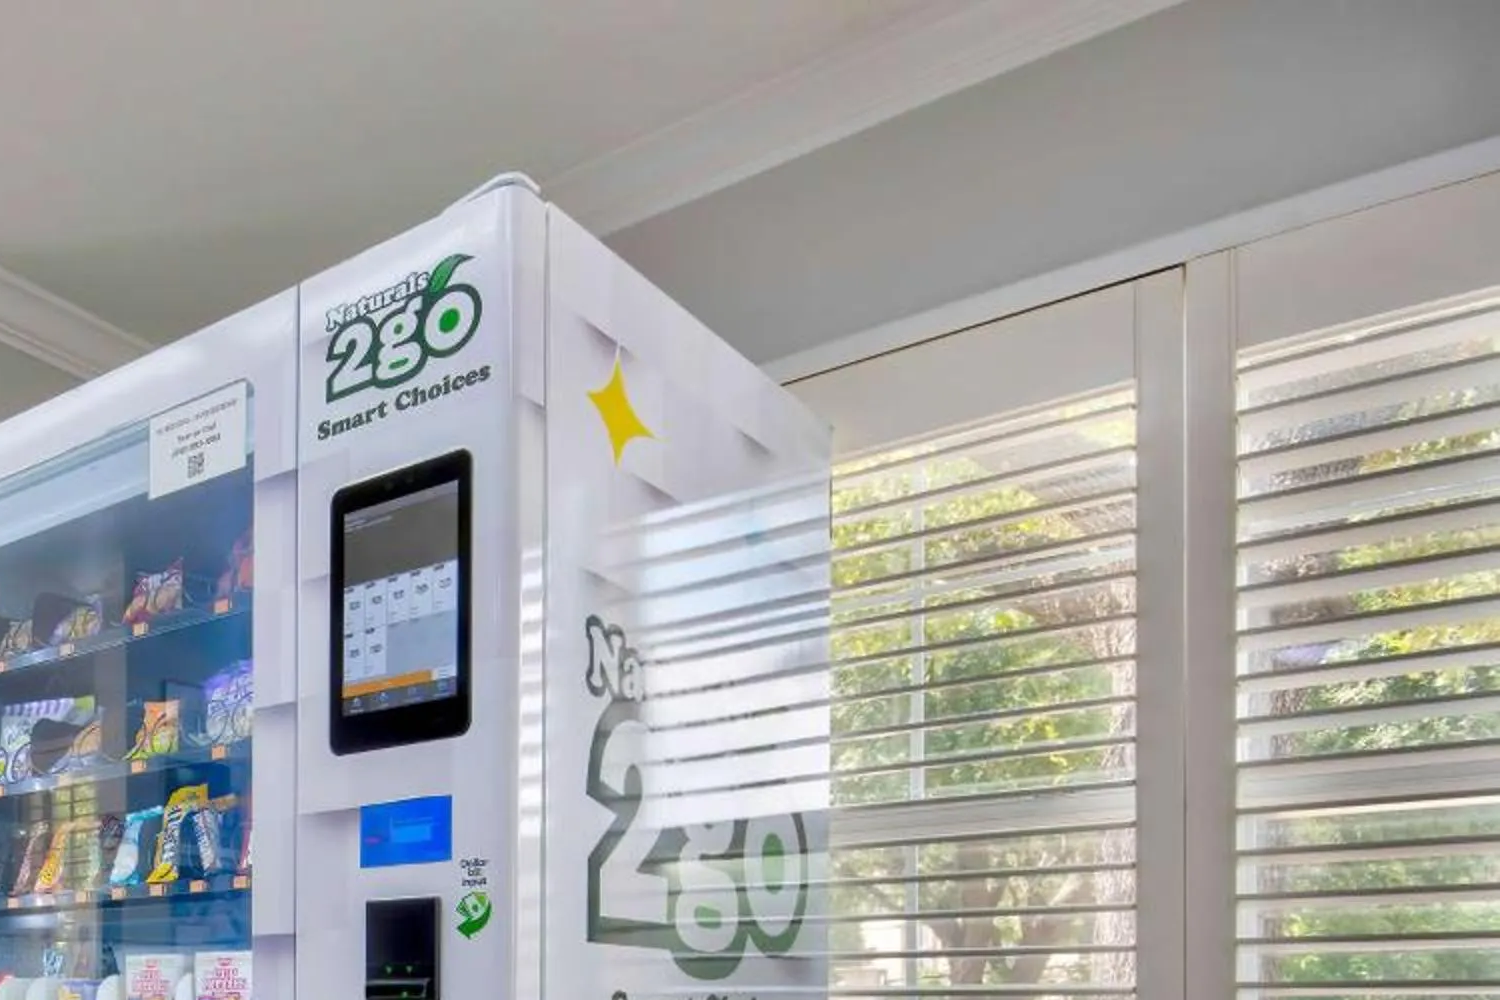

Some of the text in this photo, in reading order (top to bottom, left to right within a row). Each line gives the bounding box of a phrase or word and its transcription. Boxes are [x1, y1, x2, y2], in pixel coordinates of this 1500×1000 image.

[325, 271, 430, 332] Naturals
[317, 364, 492, 441] Smart Choices
